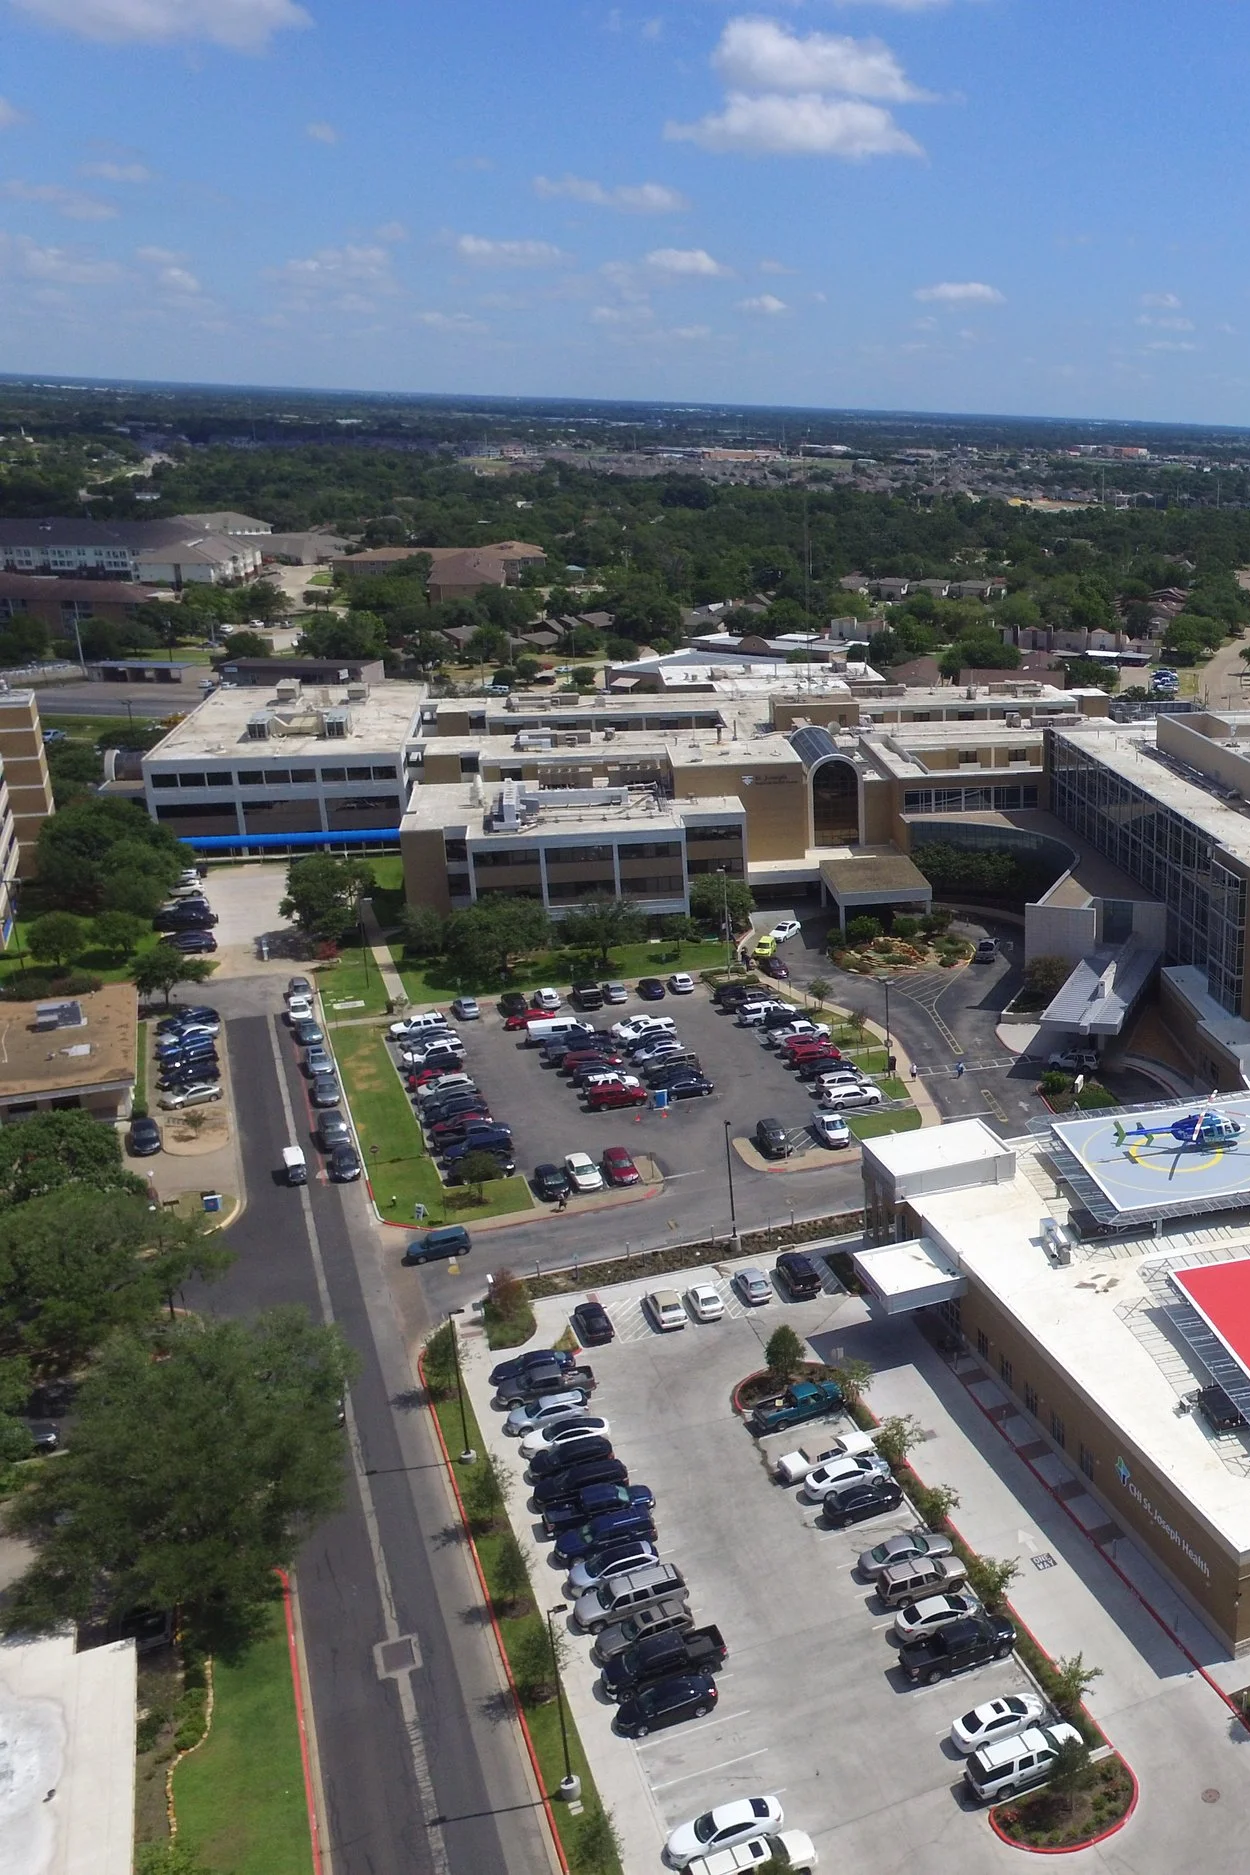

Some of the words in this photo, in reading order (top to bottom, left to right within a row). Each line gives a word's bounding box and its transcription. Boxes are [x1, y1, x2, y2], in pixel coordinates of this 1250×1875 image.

[1129, 1483, 1142, 1504] CHI
[1143, 1497, 1153, 1516] St.
[1154, 1509, 1181, 1546] Joseph
[1182, 1540, 1211, 1578] Health
[1033, 1553, 1052, 1564] ONE
[1037, 1560, 1055, 1571] WAY
